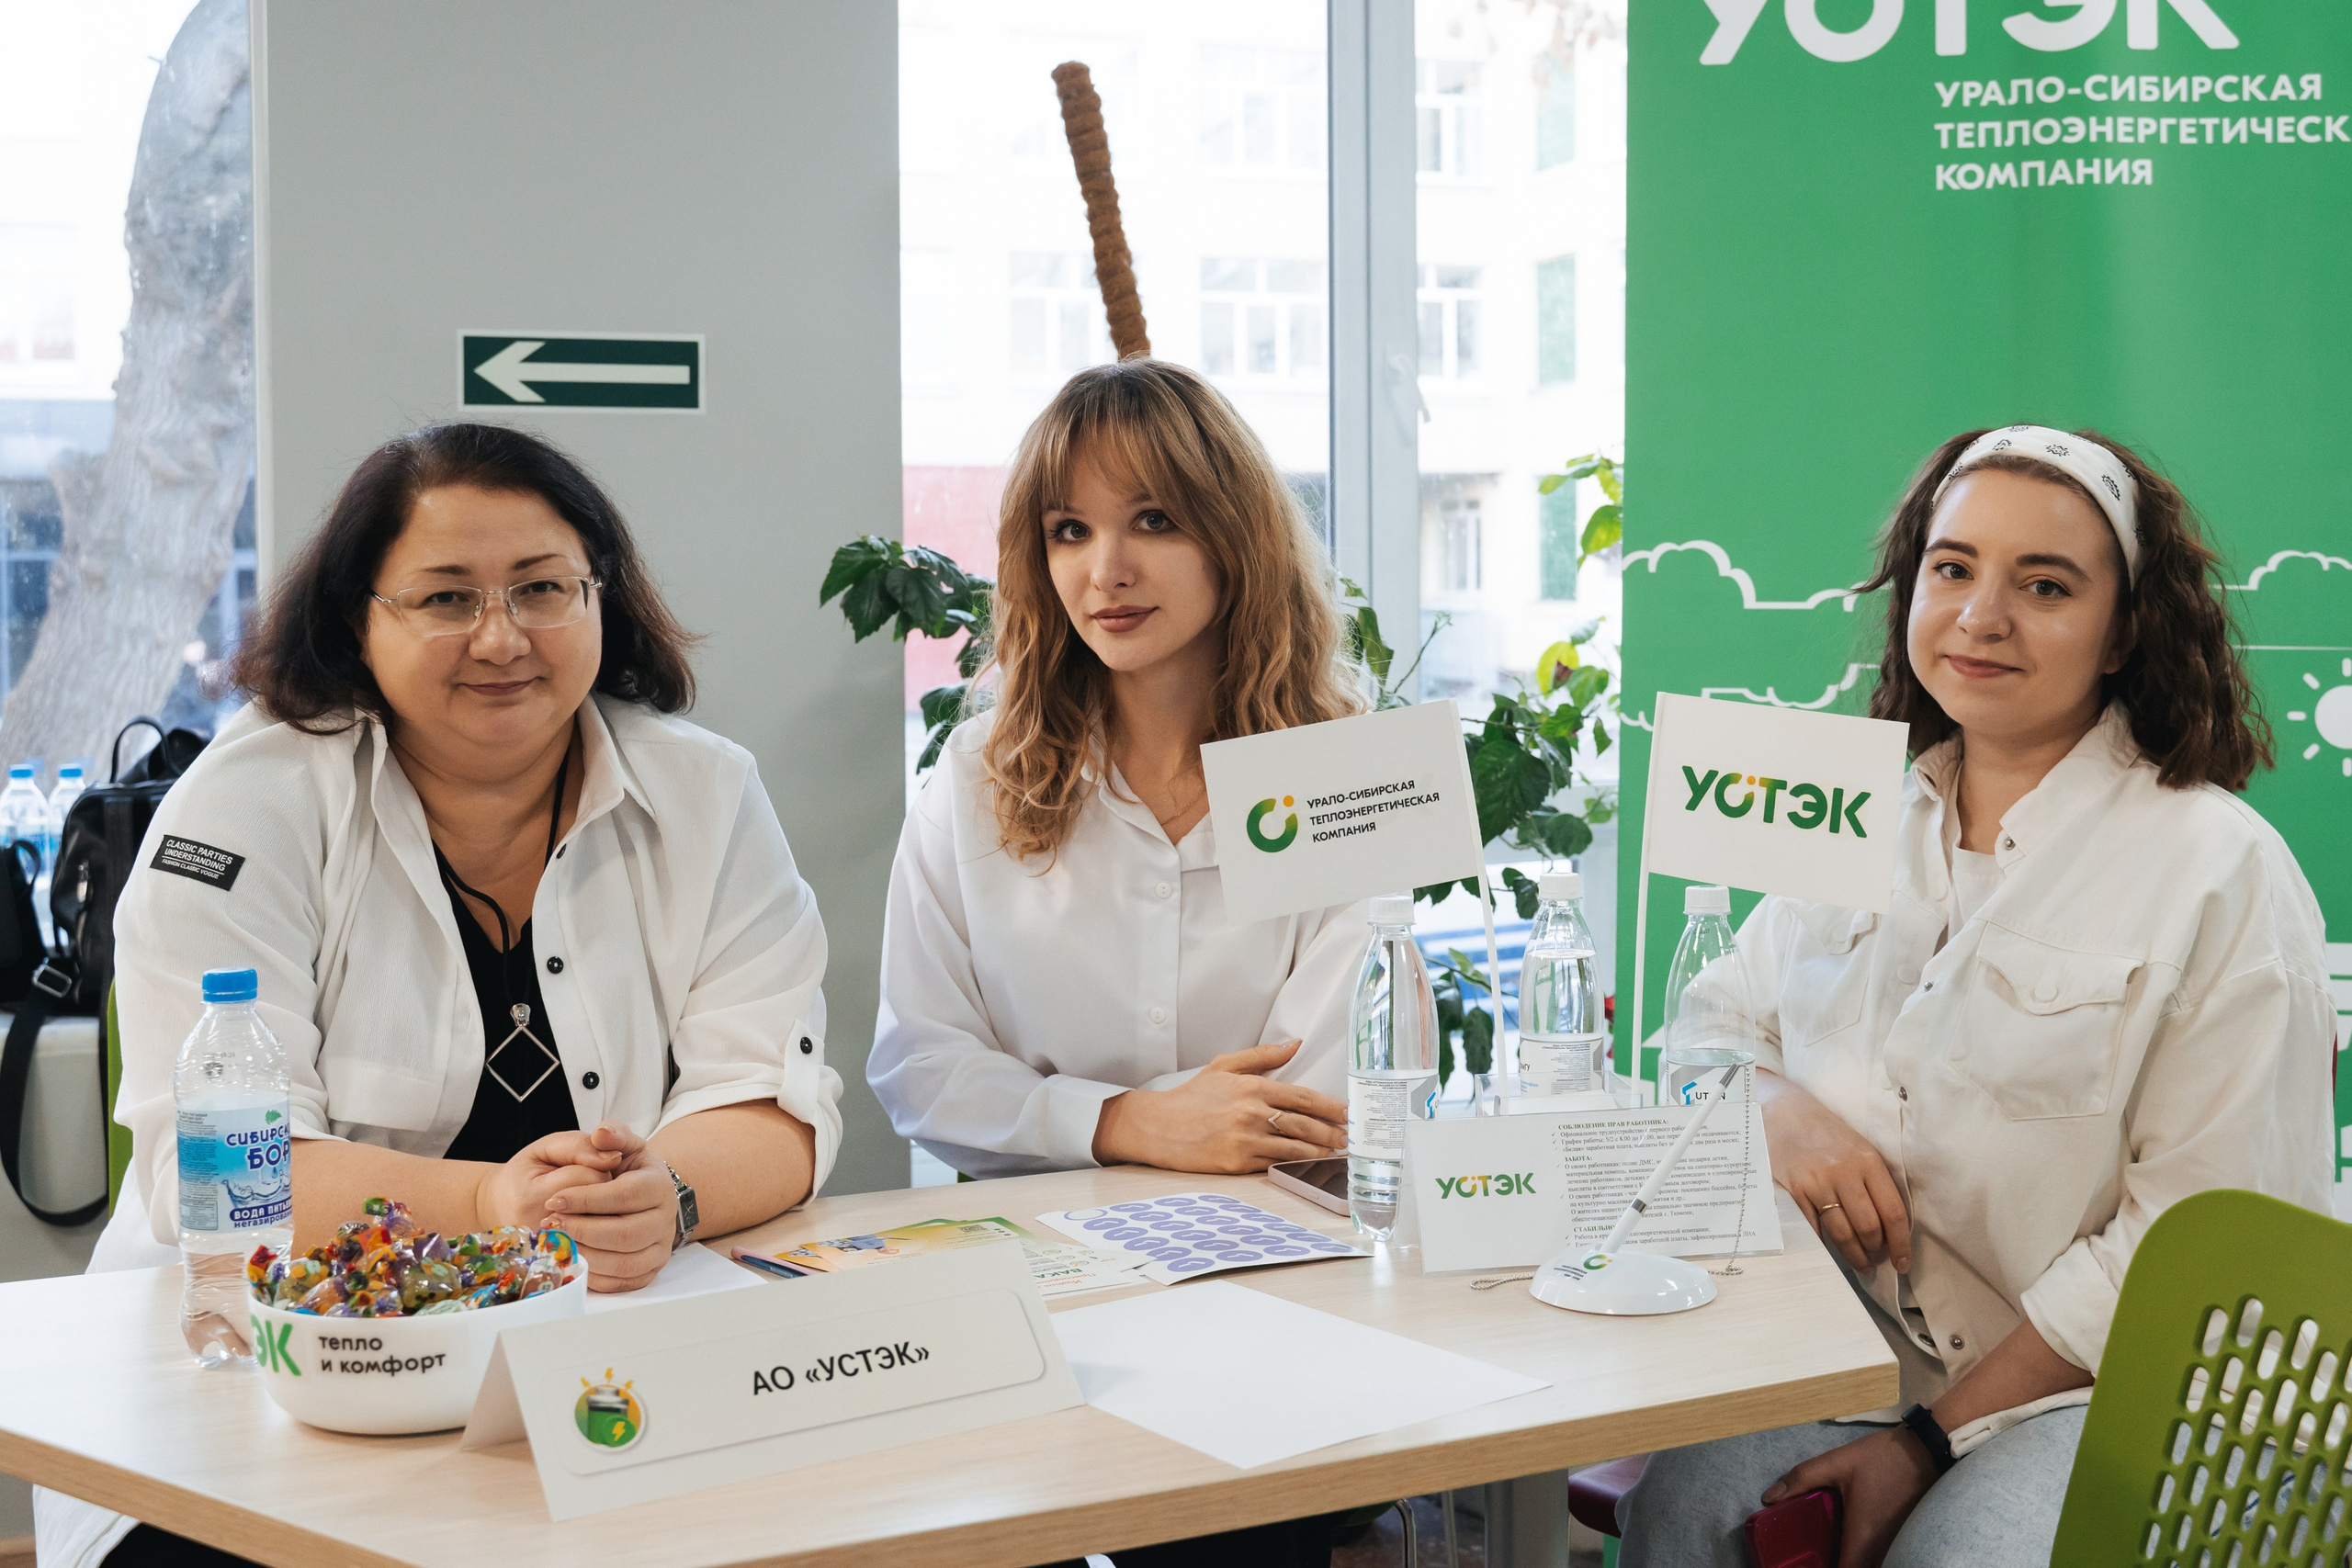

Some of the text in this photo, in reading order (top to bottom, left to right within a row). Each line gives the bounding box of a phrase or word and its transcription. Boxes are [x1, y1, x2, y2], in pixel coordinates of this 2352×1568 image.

[1933, 73, 2323, 107] УРАЛО-СИБИРСКАЯ
[1933, 116, 2352, 149] ТЕПЛОЭНЕРГЕТИЧЕСК
[1934, 159, 2154, 191] КОМПАНИЯ
[1306, 780, 1416, 809] УРАЛО-СИБИРСКАЯ
[1681, 765, 1871, 839] УСТЭК
[1309, 792, 1440, 826] ТЕПЛОЭНЕРГЕТИЧЕСКАЯ
[1312, 822, 1376, 843] КОМПАНИЯ
[164, 848, 226, 872] UNDERSTANDING
[166, 840, 233, 864] CLASSIC PARTIES
[200, 867, 220, 879] VOGUE
[1695, 1091, 1725, 1100] UTN
[1558, 1122, 1606, 1130] СОБЛЮДЕНИЕ
[1599, 1128, 1644, 1136] трудоустройство
[247, 1140, 289, 1169] БОР
[1435, 1173, 1537, 1200] УСТЭК
[234, 1207, 265, 1220] ВОДА
[319, 1336, 383, 1351] тепло
[321, 1353, 446, 1377] и комфорт
[752, 1341, 931, 1395] АО «УСТЭК»
